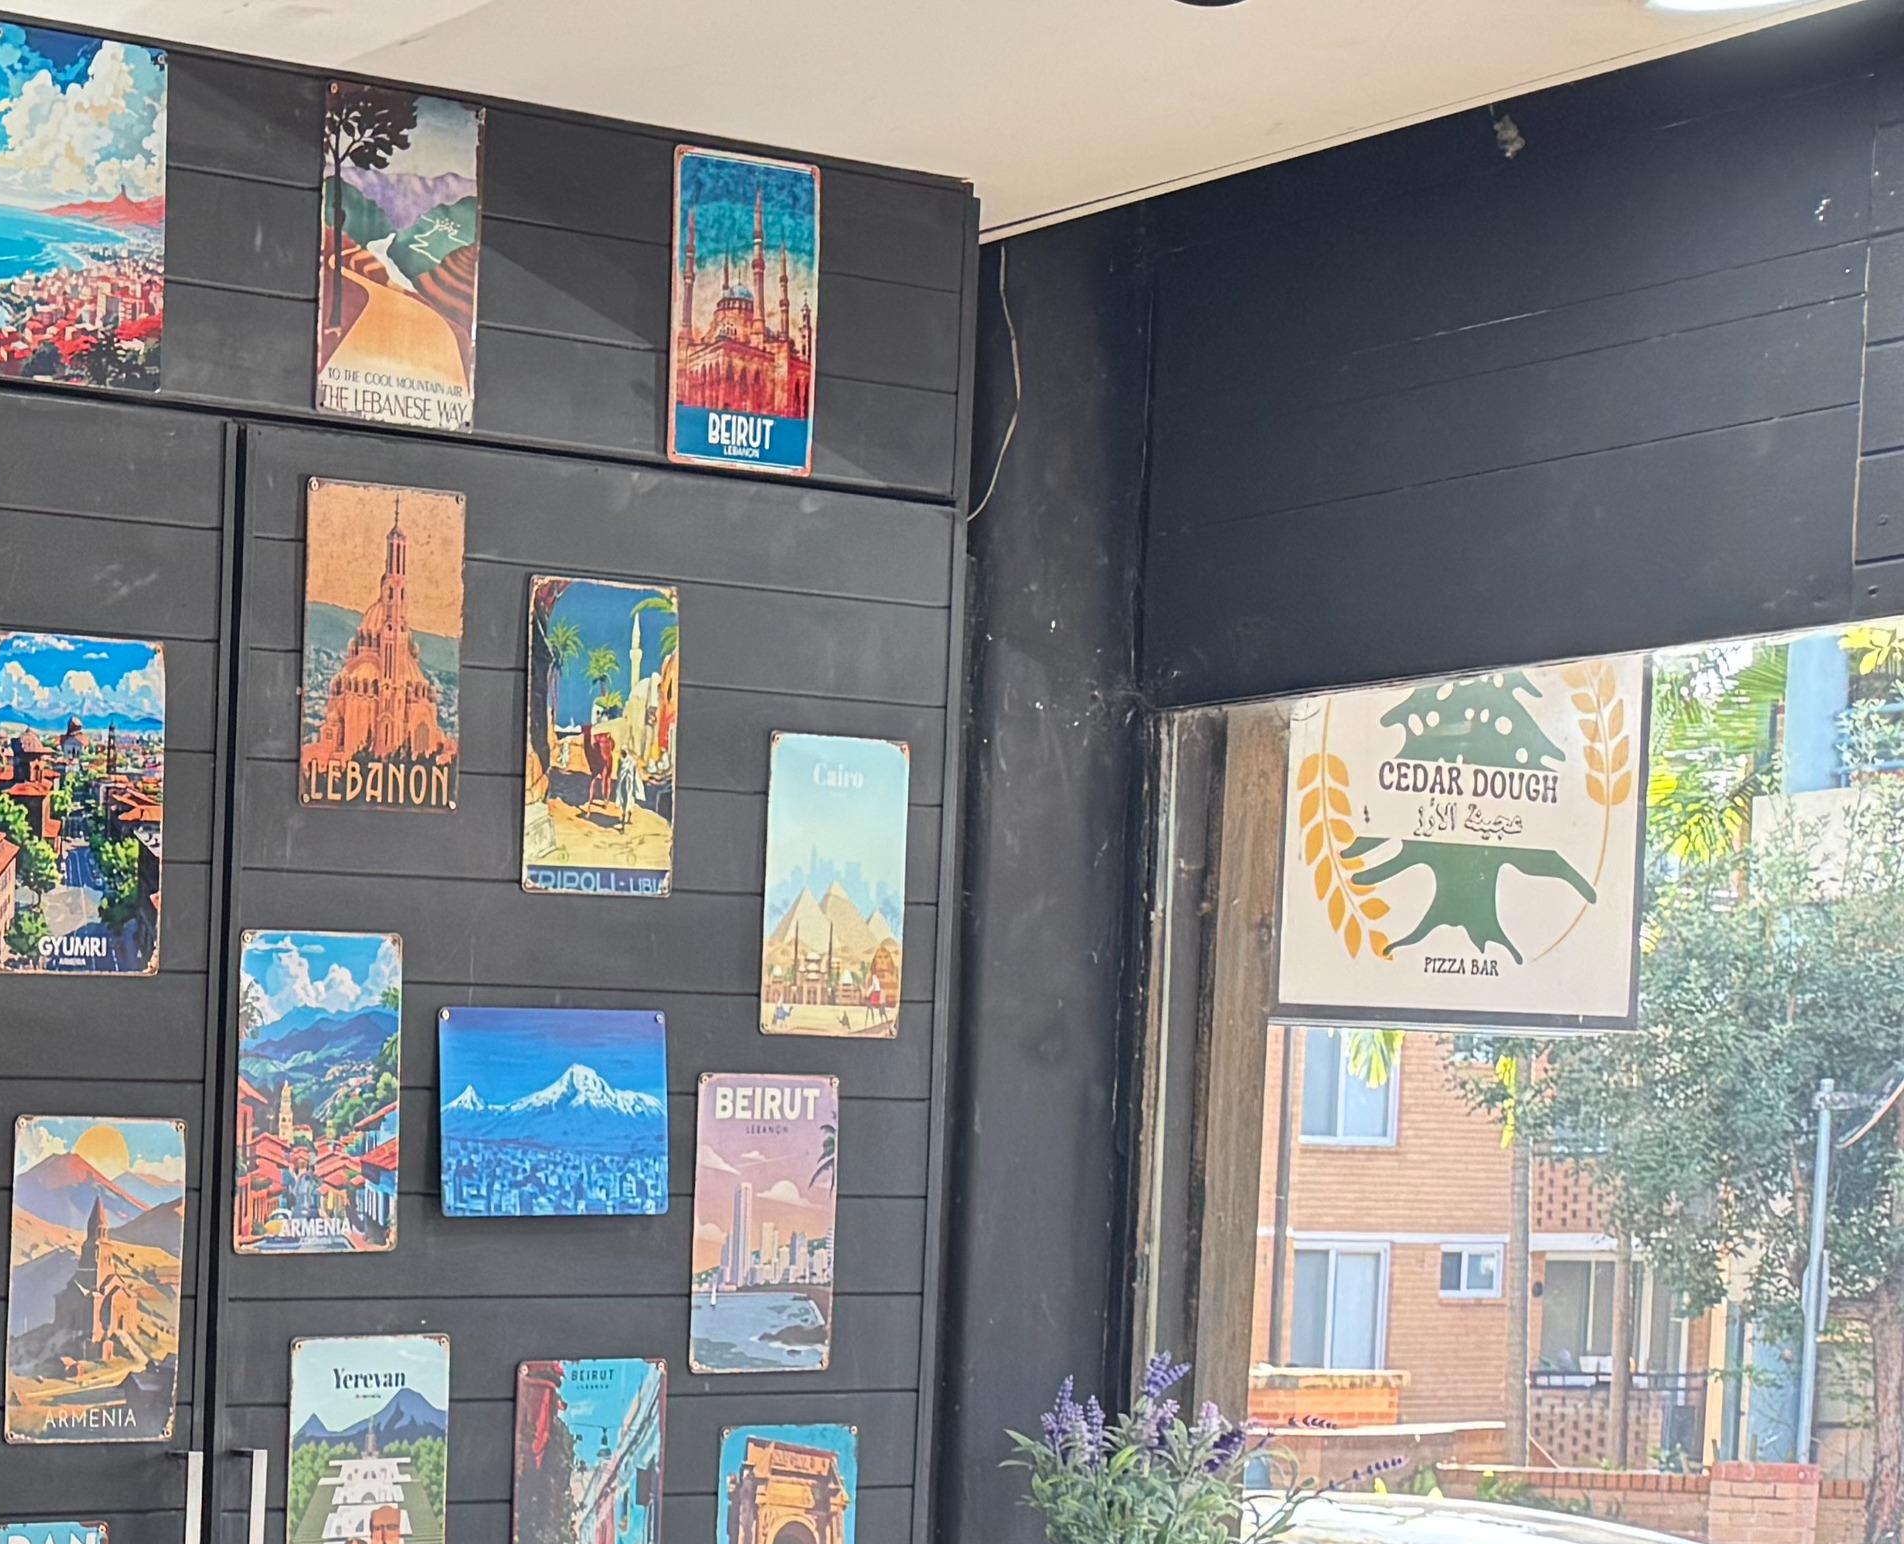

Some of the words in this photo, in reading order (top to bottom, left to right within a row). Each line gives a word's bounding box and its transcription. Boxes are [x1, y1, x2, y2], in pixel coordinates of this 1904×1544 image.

[365, 371, 391, 388] COOL
[322, 384, 348, 410] THE
[354, 389, 431, 421] LEBANESE
[437, 401, 468, 425] WAY
[708, 412, 774, 450] BEIRUT
[310, 759, 448, 805] LEBANON
[813, 762, 863, 788] Cairo
[1378, 761, 1464, 796] CEDAR
[1472, 769, 1558, 803] DOUGH
[39, 936, 107, 957] GYUMRI
[1424, 957, 1466, 975] PIZZA
[1471, 959, 1499, 977] BAR
[715, 1086, 821, 1121] BEIRUT
[746, 1125, 789, 1136] LEBANON
[280, 1218, 352, 1238] ARMENIA
[332, 1367, 406, 1389] Yerevan
[571, 1369, 615, 1381] BEIRUT
[44, 1408, 136, 1429] ARMENIA
